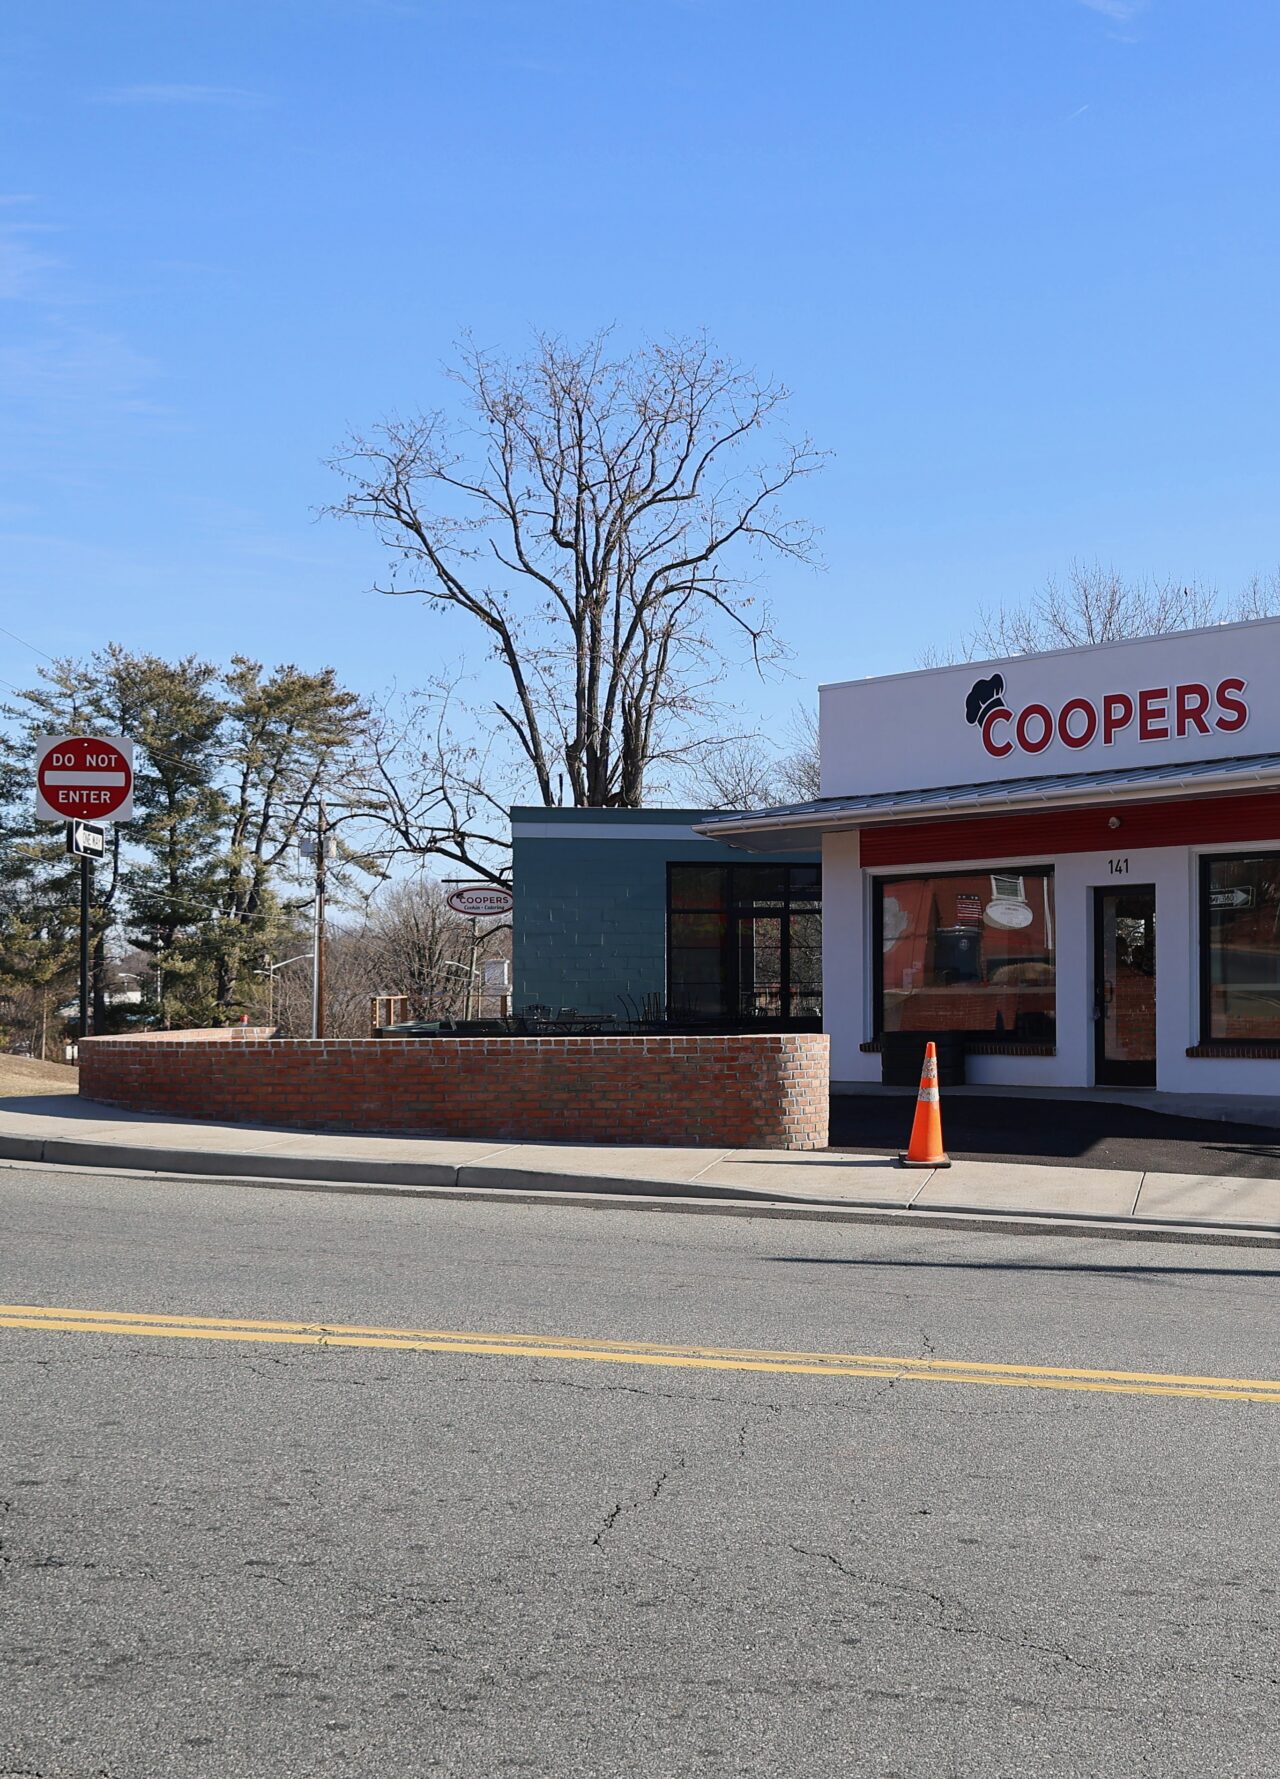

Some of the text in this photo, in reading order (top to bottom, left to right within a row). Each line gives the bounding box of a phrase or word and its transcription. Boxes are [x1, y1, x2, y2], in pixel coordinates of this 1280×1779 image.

[981, 677, 1248, 758] COOPERS
[52, 753, 118, 768] DO NOT
[58, 790, 111, 804] ENTER
[1108, 858, 1129, 874] 141
[459, 896, 509, 904] COOPERS
